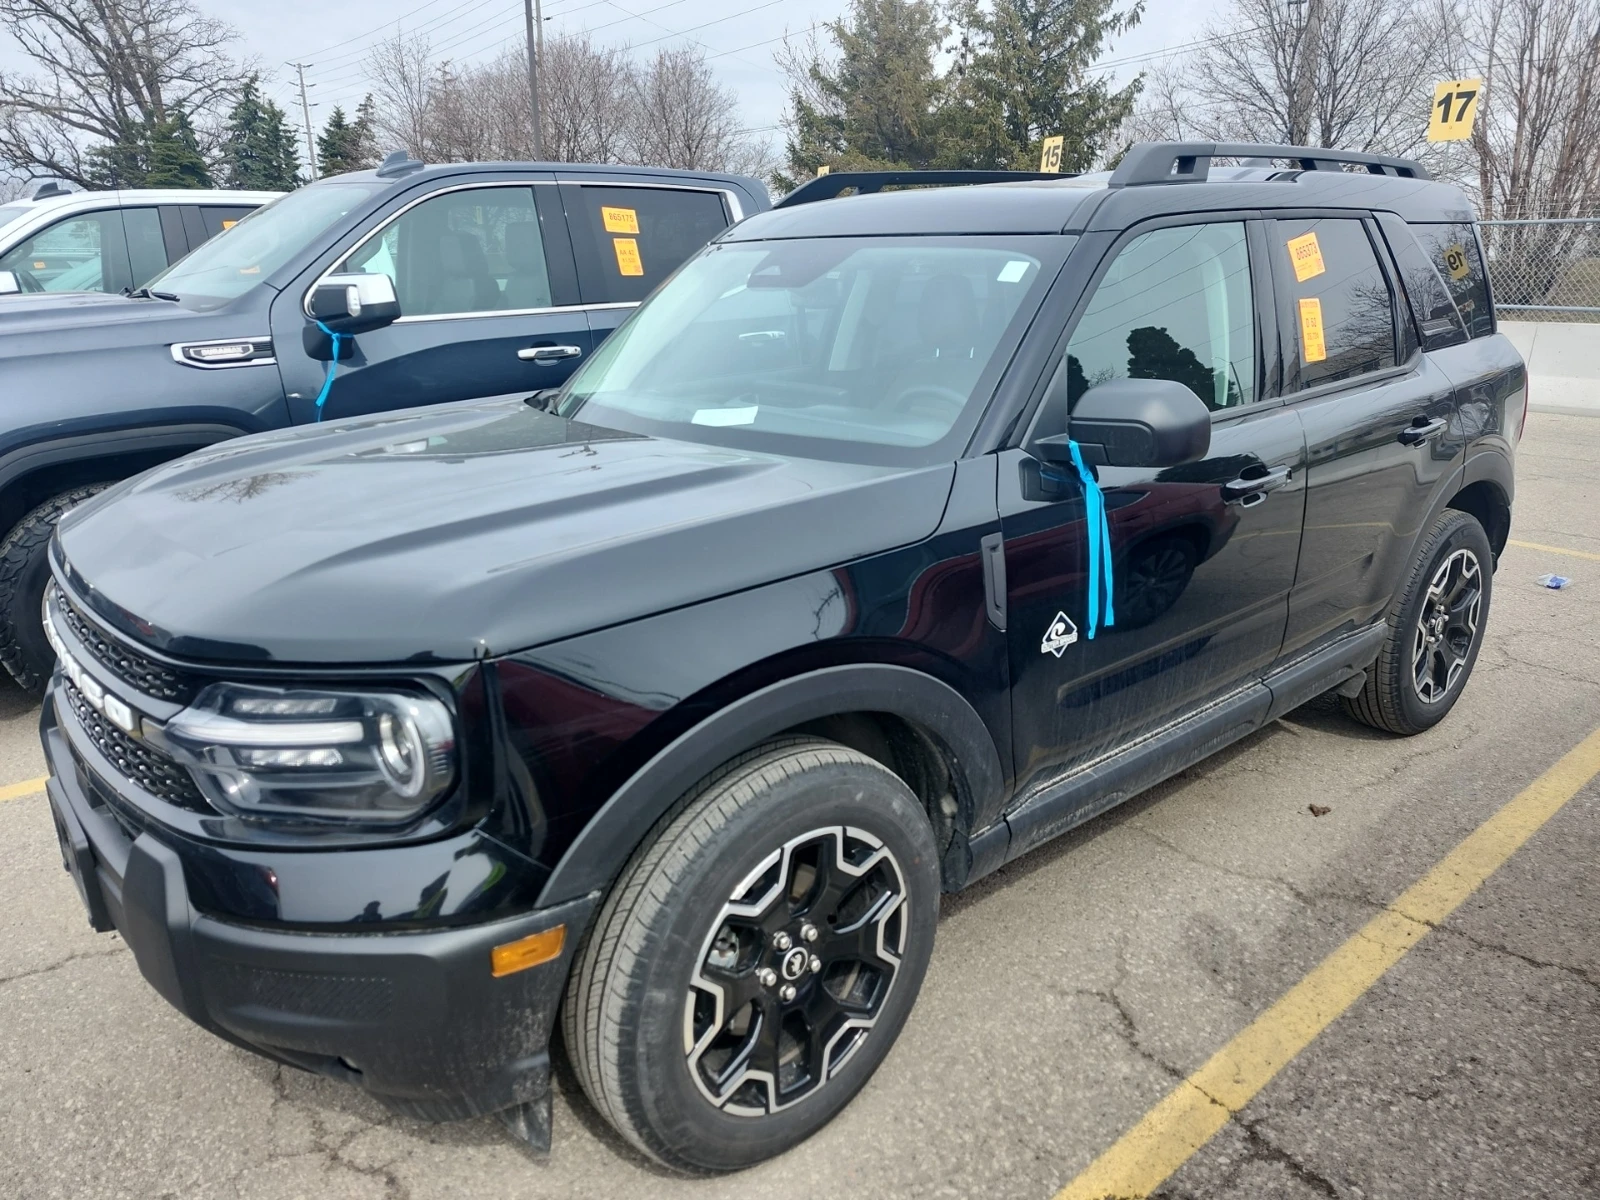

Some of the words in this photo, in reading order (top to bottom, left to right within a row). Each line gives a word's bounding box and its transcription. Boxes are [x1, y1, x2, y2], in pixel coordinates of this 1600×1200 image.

[1436, 90, 1477, 124] 17
[1044, 144, 1061, 168] 15
[608, 213, 634, 222] 865175
[1295, 241, 1318, 260] 865373
